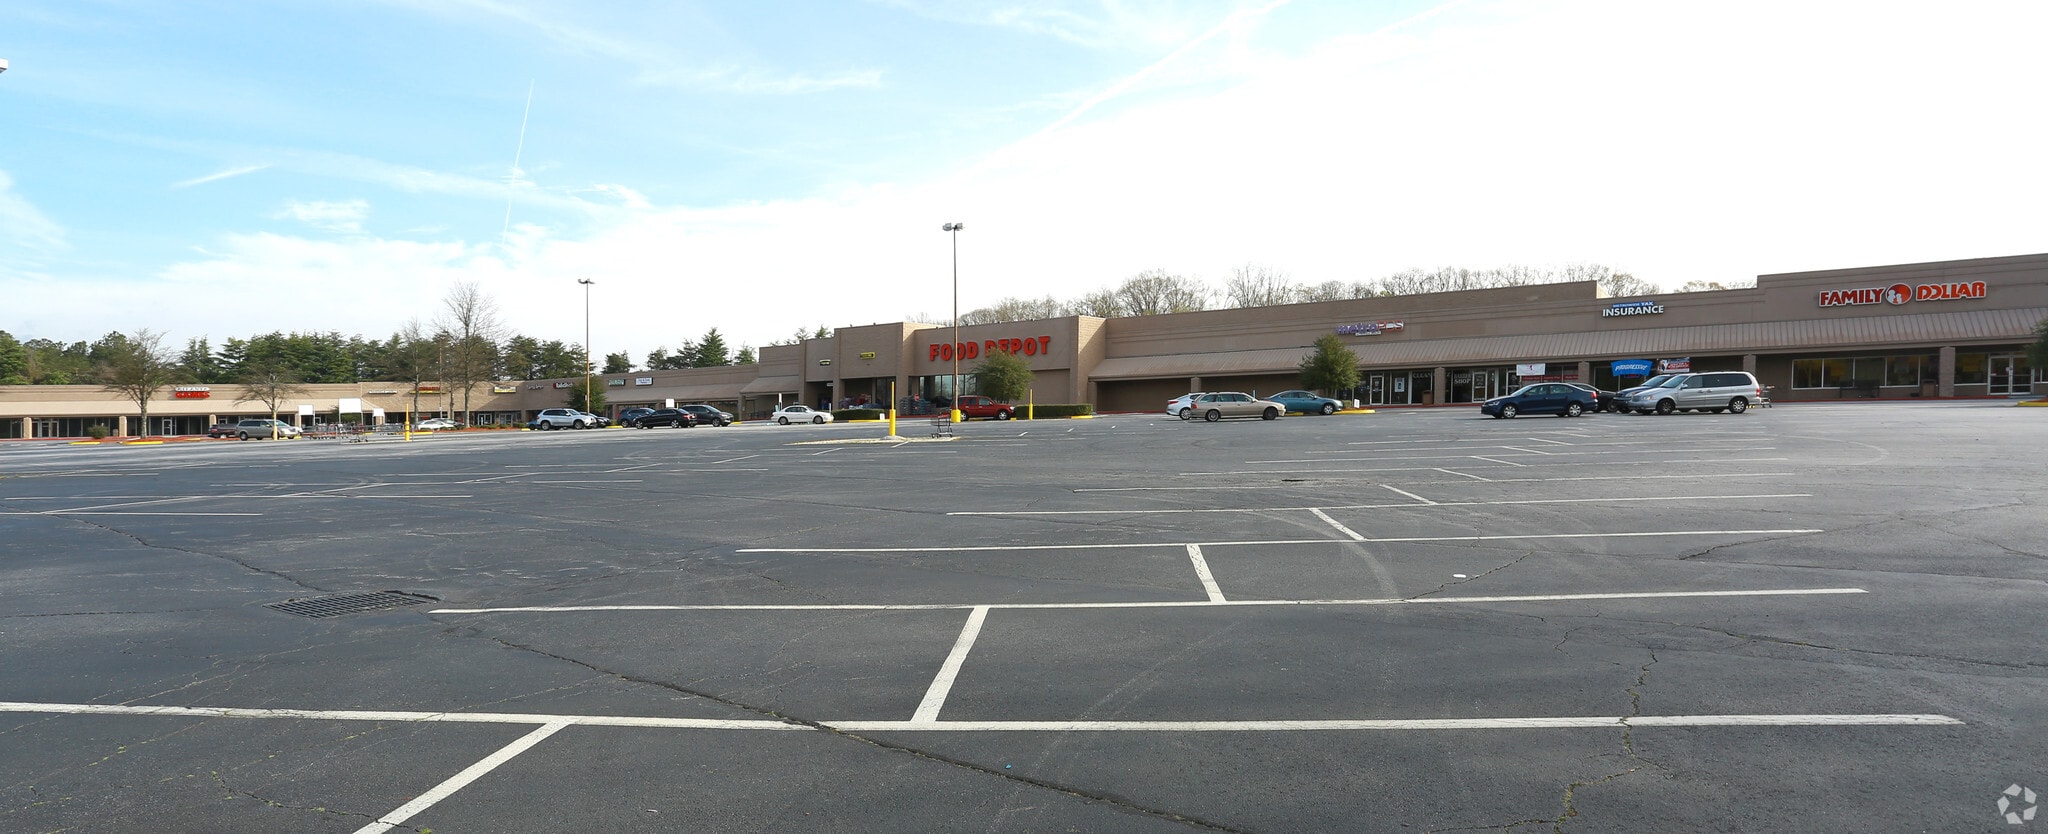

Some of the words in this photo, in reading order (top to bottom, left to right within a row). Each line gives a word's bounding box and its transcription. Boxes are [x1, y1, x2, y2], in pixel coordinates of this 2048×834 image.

[1820, 288, 1884, 306] FAMILY
[1916, 281, 1986, 301] DOLLAR
[1602, 305, 1665, 317] INSURANCE
[929, 341, 979, 362] FOOD
